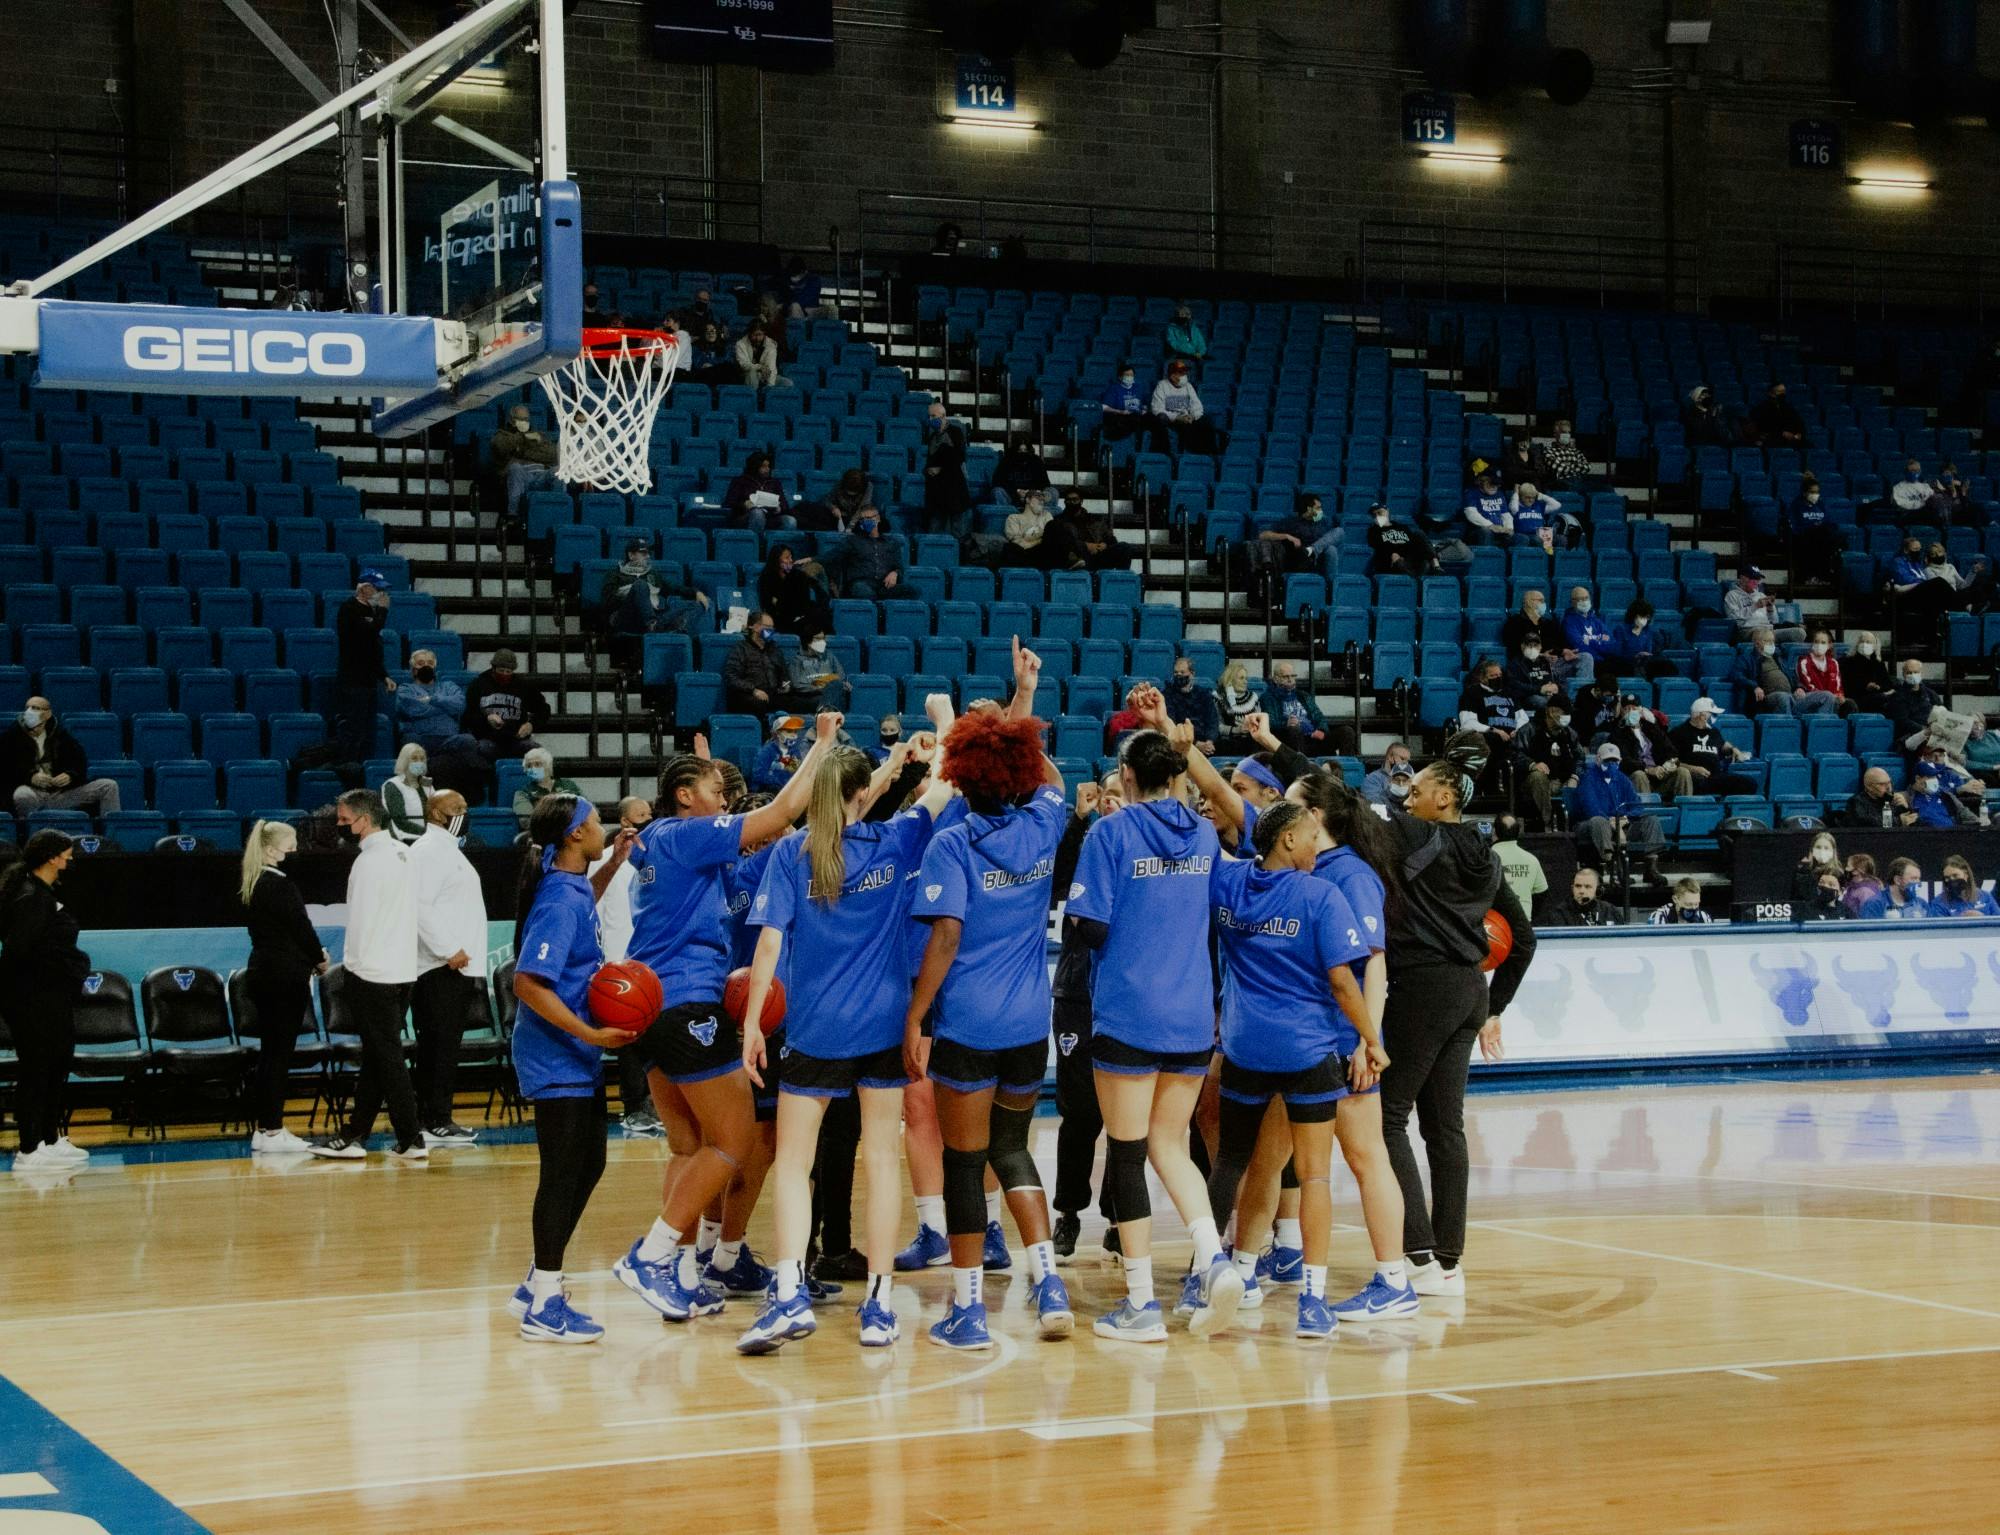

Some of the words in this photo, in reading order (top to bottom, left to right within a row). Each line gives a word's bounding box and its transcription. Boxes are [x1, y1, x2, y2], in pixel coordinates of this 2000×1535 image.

[714, 0, 775, 11] 1993-1998
[967, 83, 1006, 107] 114
[1412, 117, 1446, 140] 115
[1800, 144, 1831, 165] 116
[123, 325, 366, 377] GEICO
[1692, 744, 1719, 755] BULLS
[983, 858, 1055, 891] BUFFAL
[1132, 856, 1212, 879] BUFFALO
[1756, 903, 1792, 918] POSS
[1347, 928, 1361, 947] 2
[537, 942, 550, 961] 3
